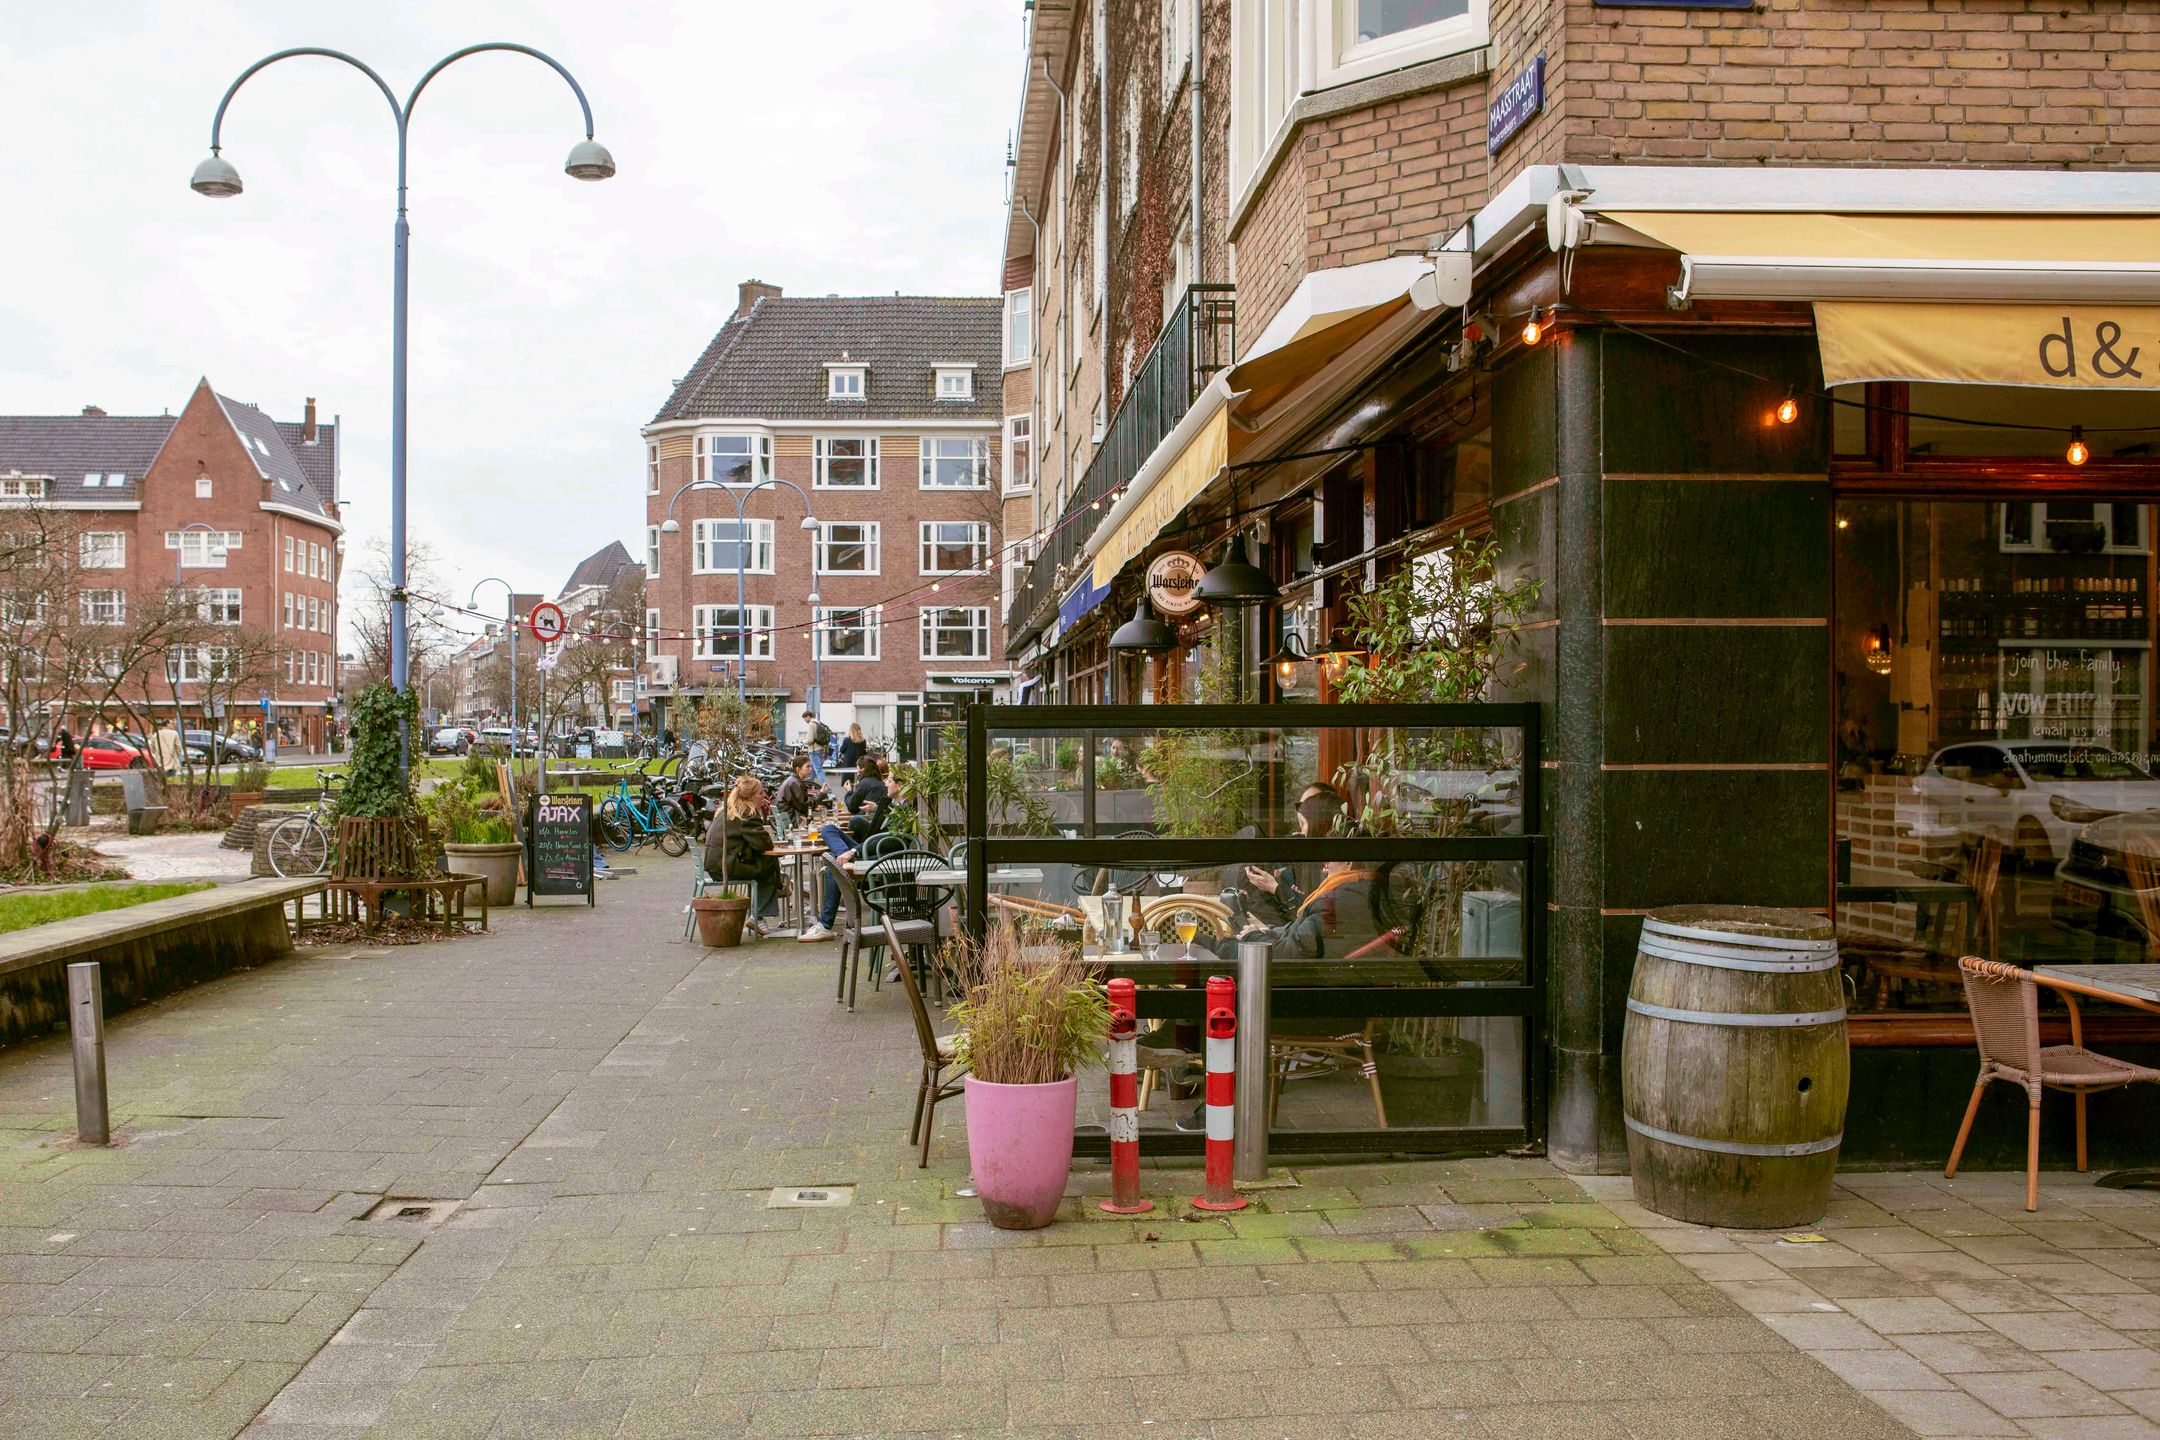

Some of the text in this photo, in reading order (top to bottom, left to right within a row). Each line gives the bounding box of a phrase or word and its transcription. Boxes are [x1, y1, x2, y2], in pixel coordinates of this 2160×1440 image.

[1490, 65, 1535, 132] MAASSTRAAT
[1521, 95, 1535, 116] ZUID
[2039, 316, 2160, 379] d&
[1153, 573, 1200, 591] Warsteine
[2009, 652, 2039, 677] join
[2046, 650, 2069, 671] the
[2000, 691, 2049, 716] NOW
[2032, 720, 2111, 737] email us at
[538, 805, 581, 823] AJAX
